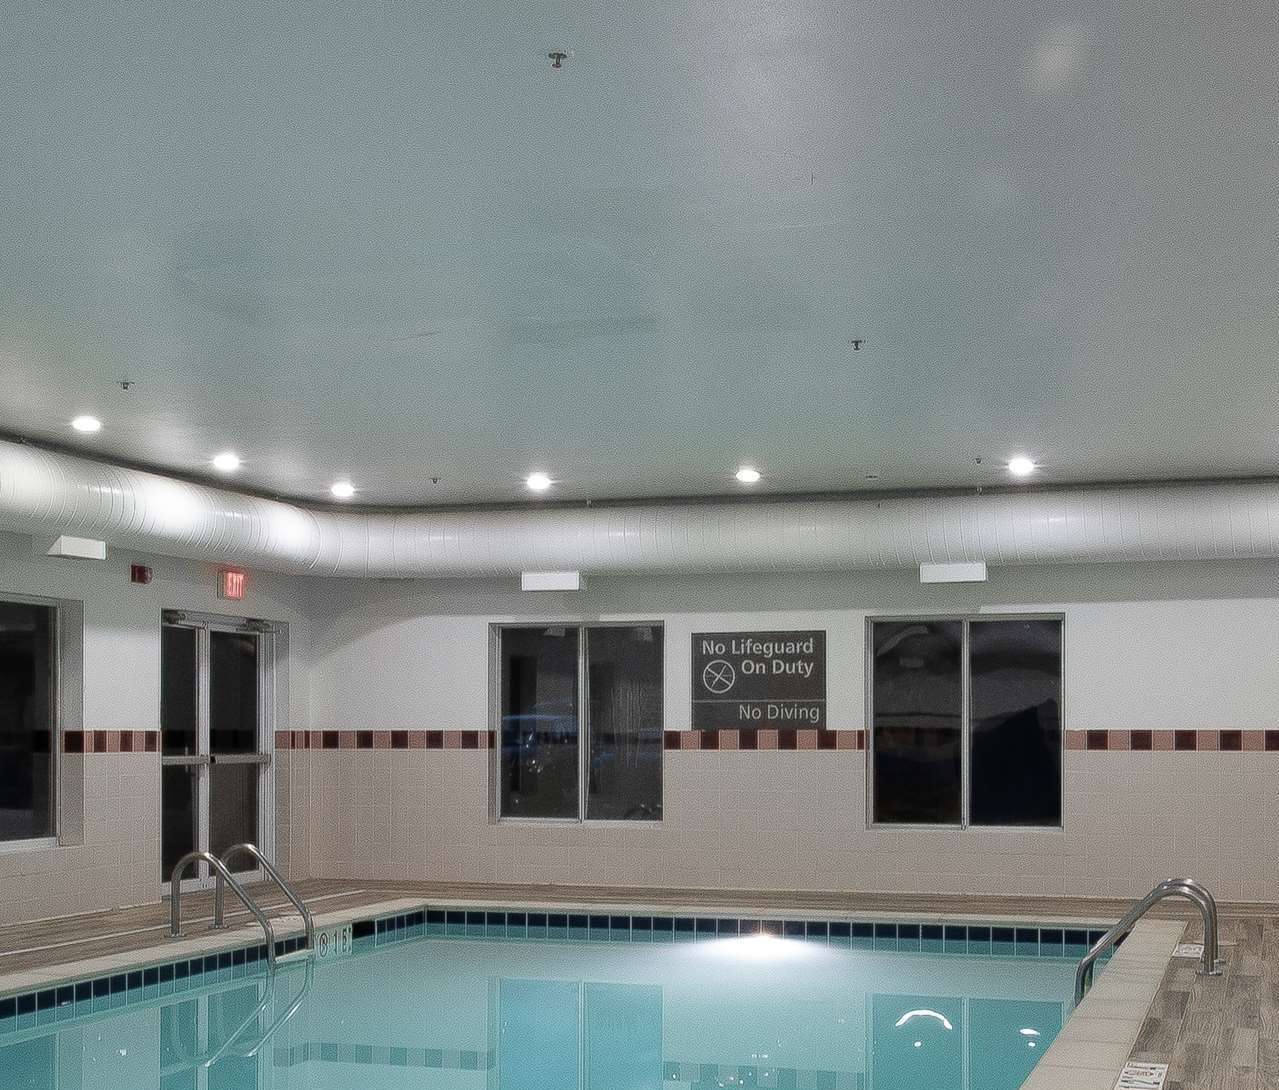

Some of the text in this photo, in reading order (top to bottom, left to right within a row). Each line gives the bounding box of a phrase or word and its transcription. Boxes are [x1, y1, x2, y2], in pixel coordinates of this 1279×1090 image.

[702, 638, 814, 658] No Lifeguard
[741, 659, 814, 678] On Duty
[739, 703, 820, 724] No Diving
